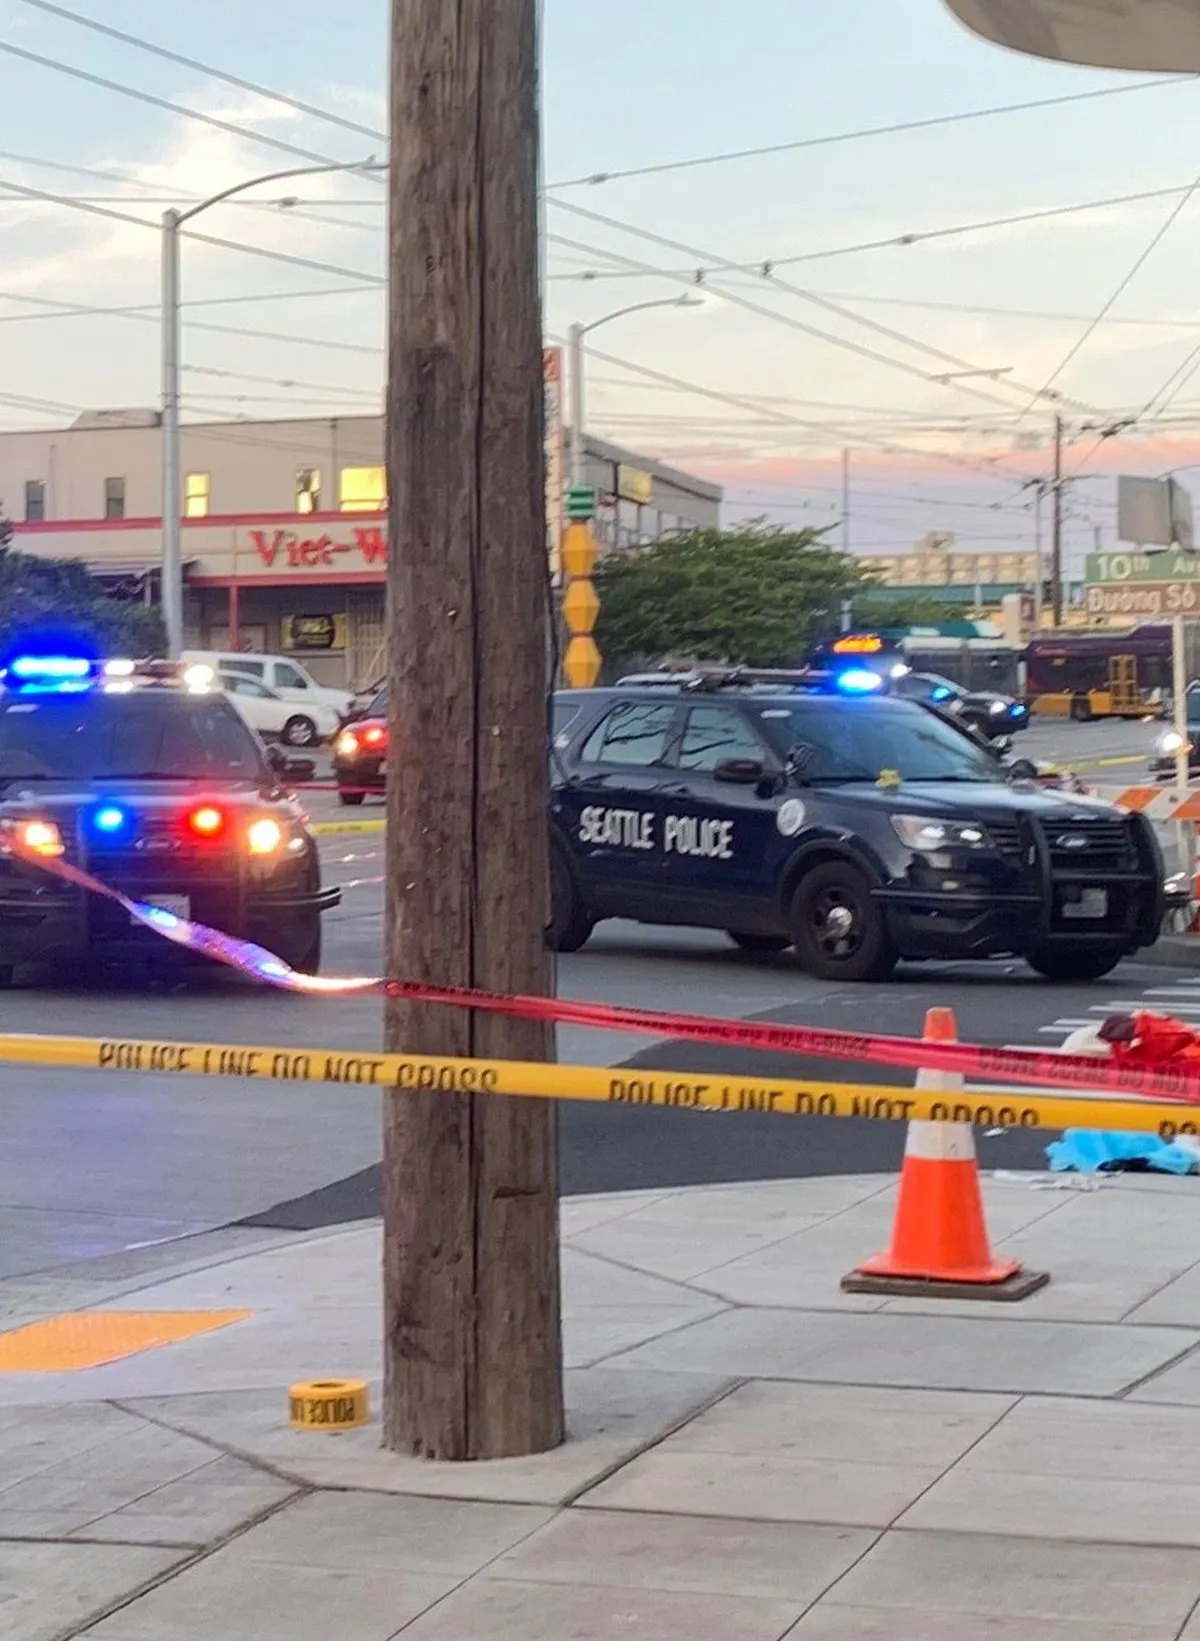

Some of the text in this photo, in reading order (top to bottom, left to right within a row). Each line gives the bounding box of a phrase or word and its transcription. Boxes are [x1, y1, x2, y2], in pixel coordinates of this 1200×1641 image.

[1097, 554, 1150, 580] 10th
[578, 805, 734, 859] SEATTLE POLICE
